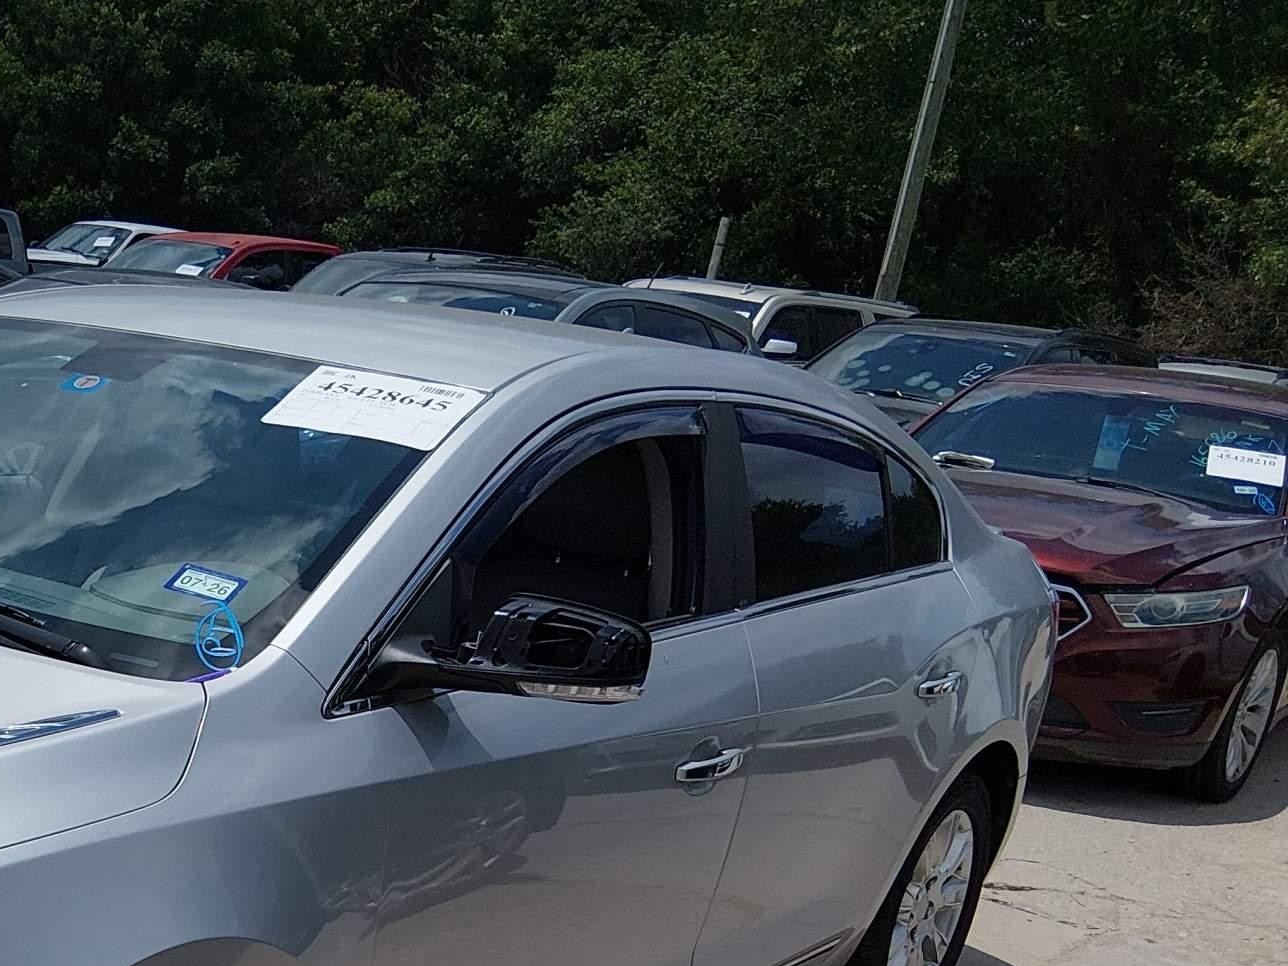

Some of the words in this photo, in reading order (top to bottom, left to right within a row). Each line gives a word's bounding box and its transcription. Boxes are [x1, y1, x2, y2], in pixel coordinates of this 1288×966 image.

[317, 381, 454, 413] 45428645
[1215, 453, 1277, 467] 45428210
[180, 575, 204, 588] 07
[206, 582, 231, 596] 26
